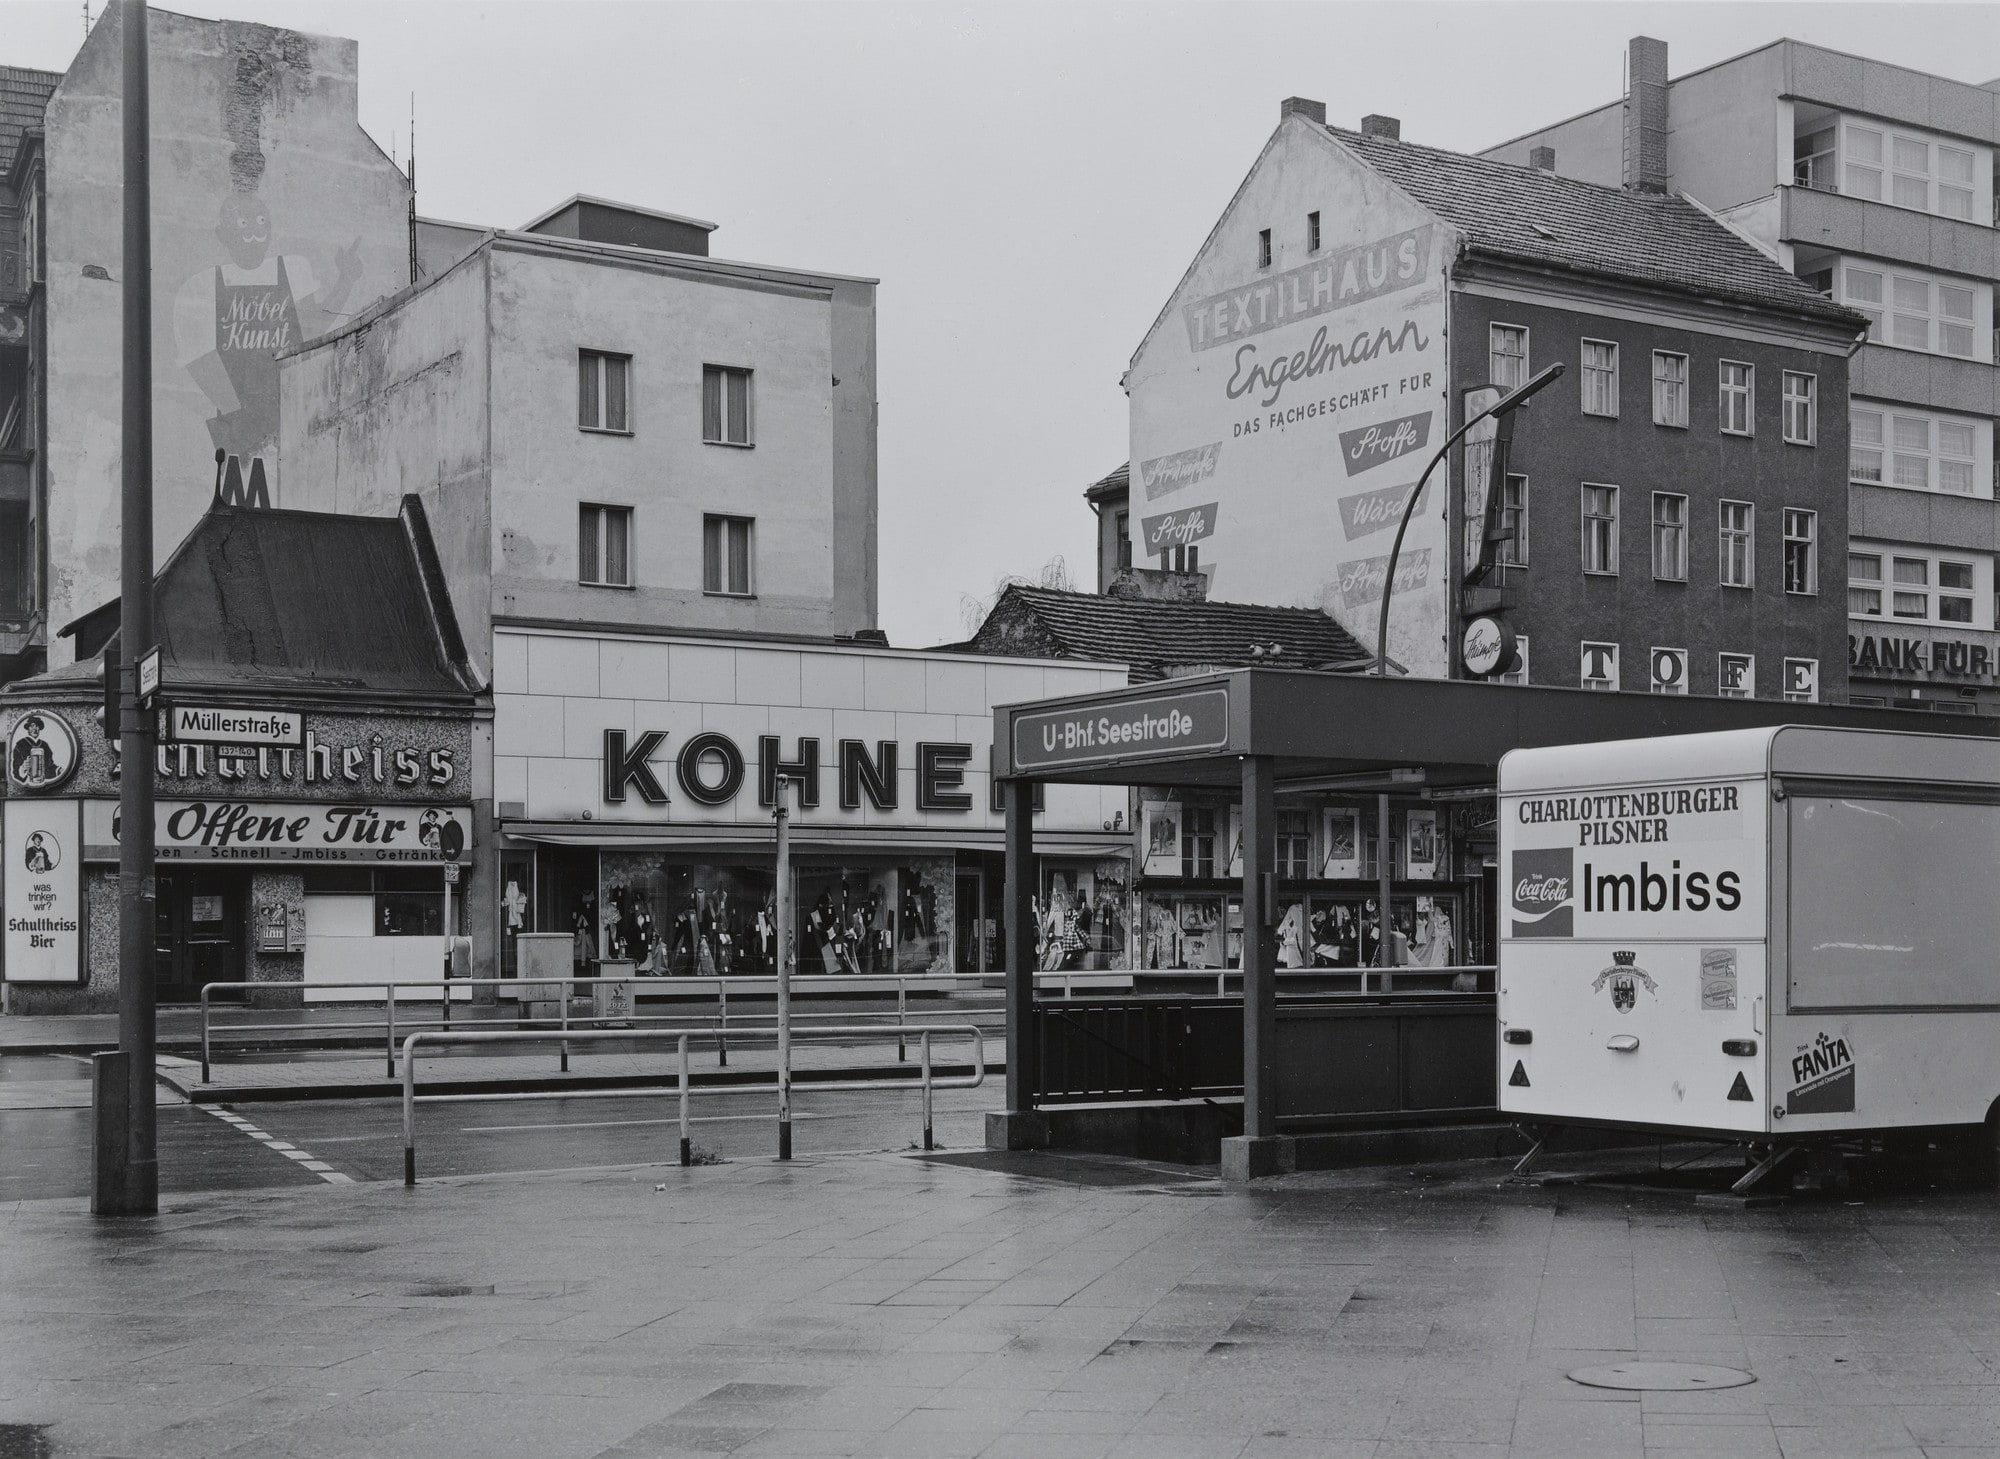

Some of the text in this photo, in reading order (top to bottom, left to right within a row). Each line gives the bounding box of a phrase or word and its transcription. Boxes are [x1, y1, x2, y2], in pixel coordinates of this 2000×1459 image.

[221, 291, 290, 322] Möbel
[1193, 237, 1419, 344] TEXTILHAUS
[222, 322, 290, 351] Kunst
[1226, 319, 1430, 408] Engelmann
[1233, 372, 1432, 438] DAS FACHGESCHÄFT FÜR
[1352, 420, 1417, 460] Stoffe
[1151, 510, 1205, 544] Stoffe
[1933, 640, 1988, 676] FÜR
[180, 711, 292, 738] Müllerstraße
[1043, 708, 1193, 752] U-Bhf. Seestraße
[1519, 786, 1739, 824] CHARLOTTENBURGER
[167, 802, 407, 846] Offene Tür
[1579, 818, 1669, 846] PILSNER
[211, 846, 270, 858] Schnell
[28, 892, 57, 901] trinken
[33, 884, 52, 892] was
[1515, 877, 1570, 902] Coca-Cola
[1584, 859, 1742, 912] Imbiss
[33, 901, 52, 911] wir?
[9, 917, 77, 932] Schultheiss
[30, 934, 56, 948] Bier
[1792, 1038, 1851, 1084] FANTA
